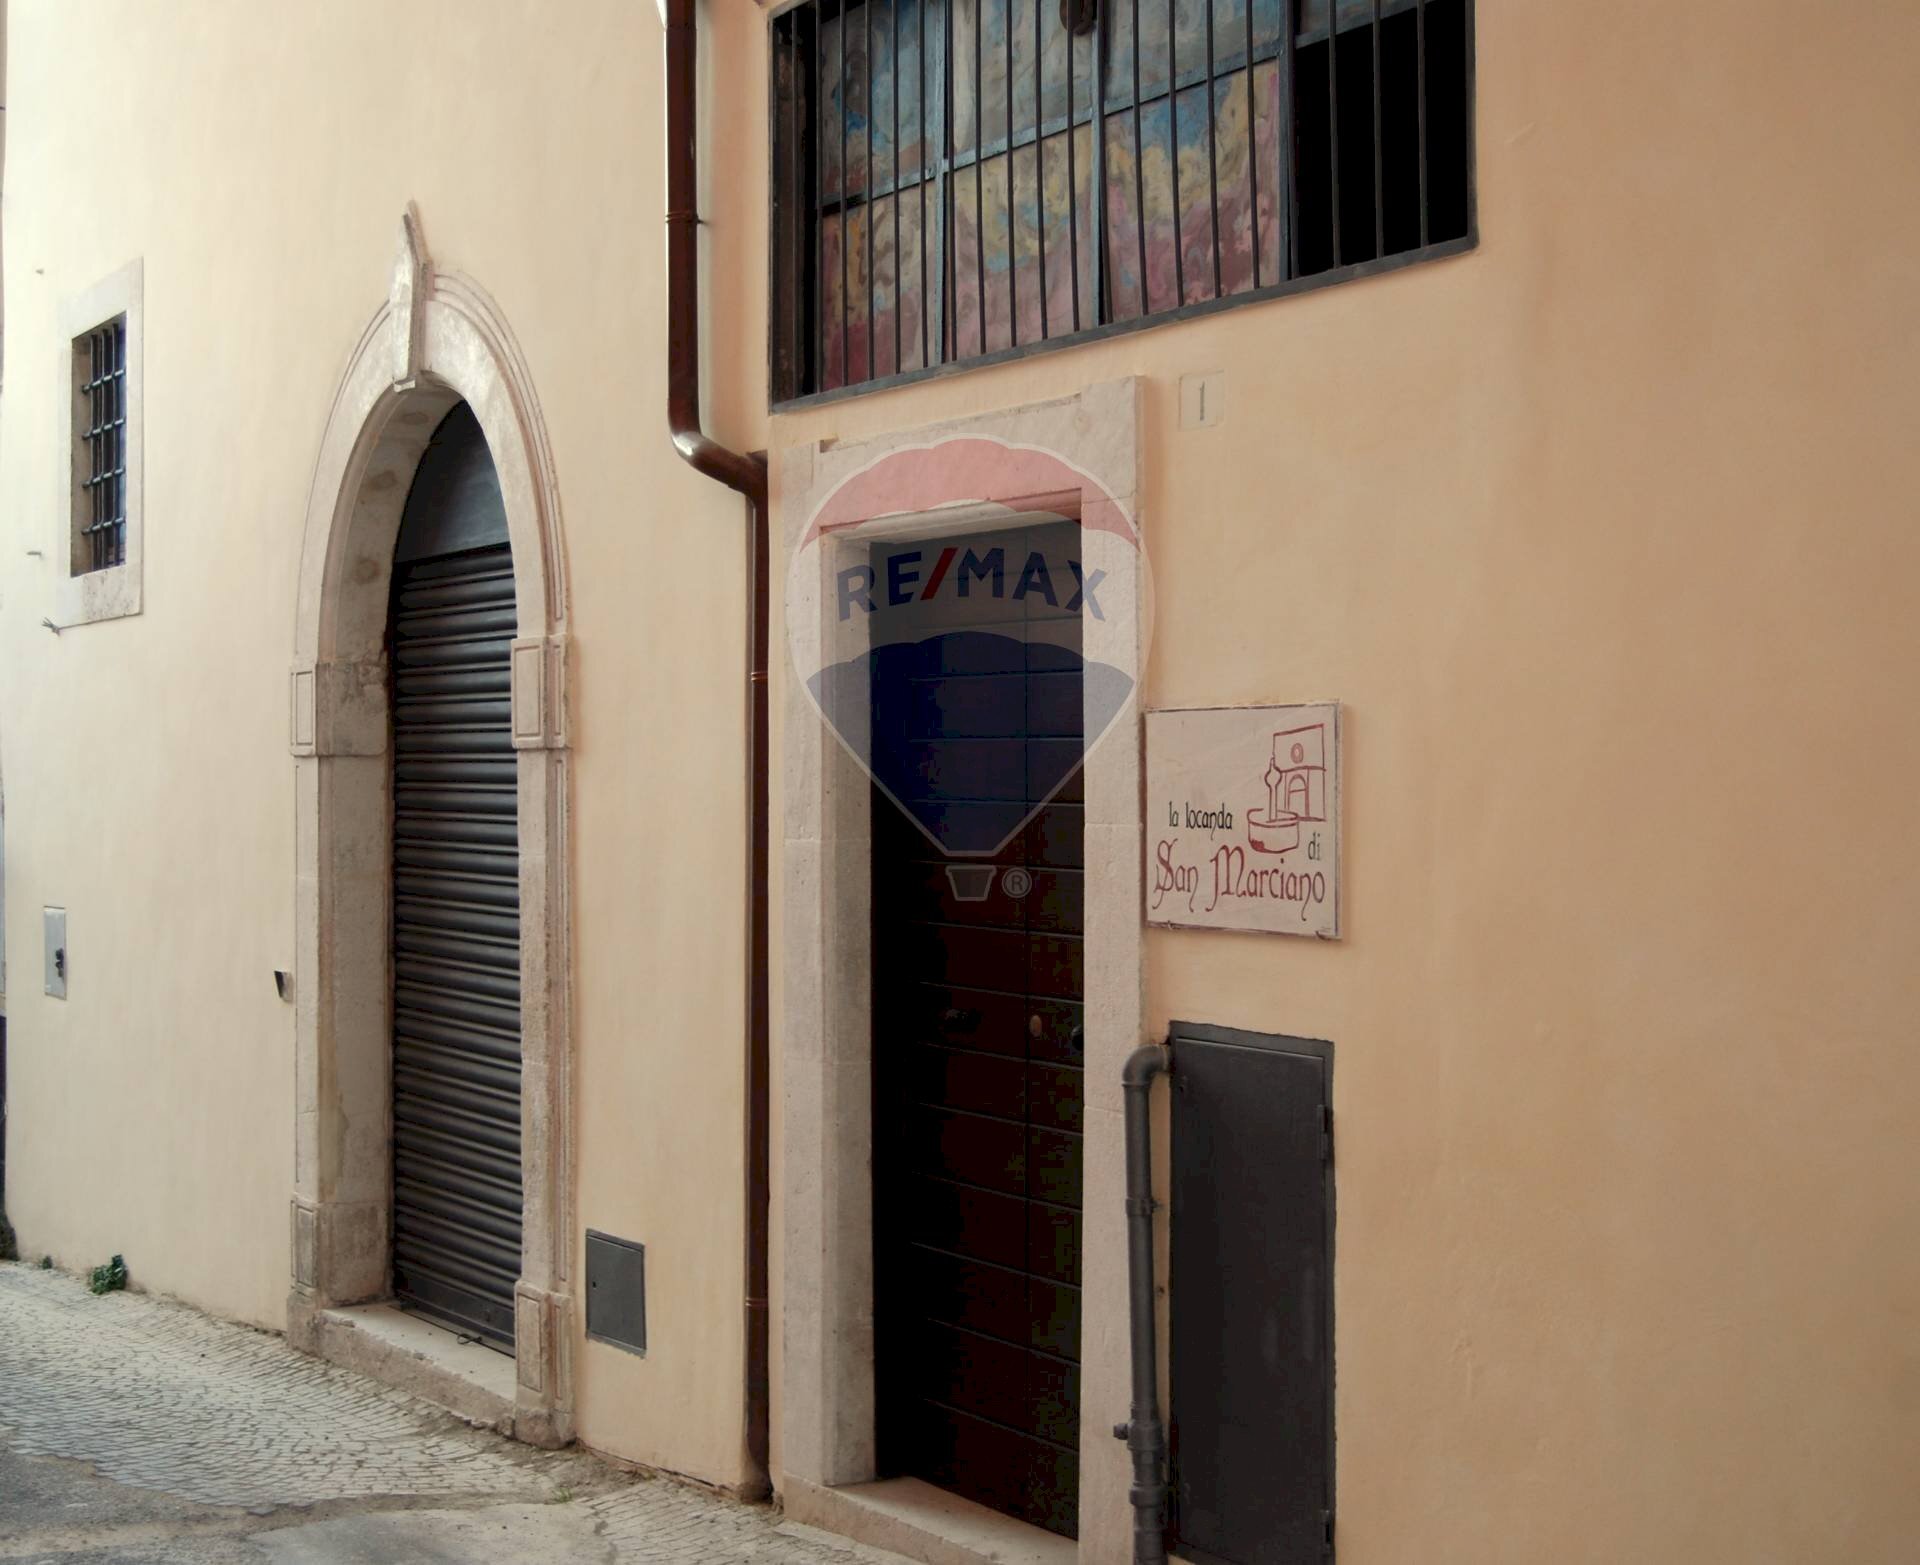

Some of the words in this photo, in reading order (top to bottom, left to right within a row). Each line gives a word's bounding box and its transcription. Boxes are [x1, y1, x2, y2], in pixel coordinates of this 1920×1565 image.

[1169, 801, 1179, 827] la
[1185, 802, 1233, 840] locanda
[1308, 832, 1321, 861] di
[1152, 838, 1199, 912] San
[1205, 845, 1325, 921] Marciano
